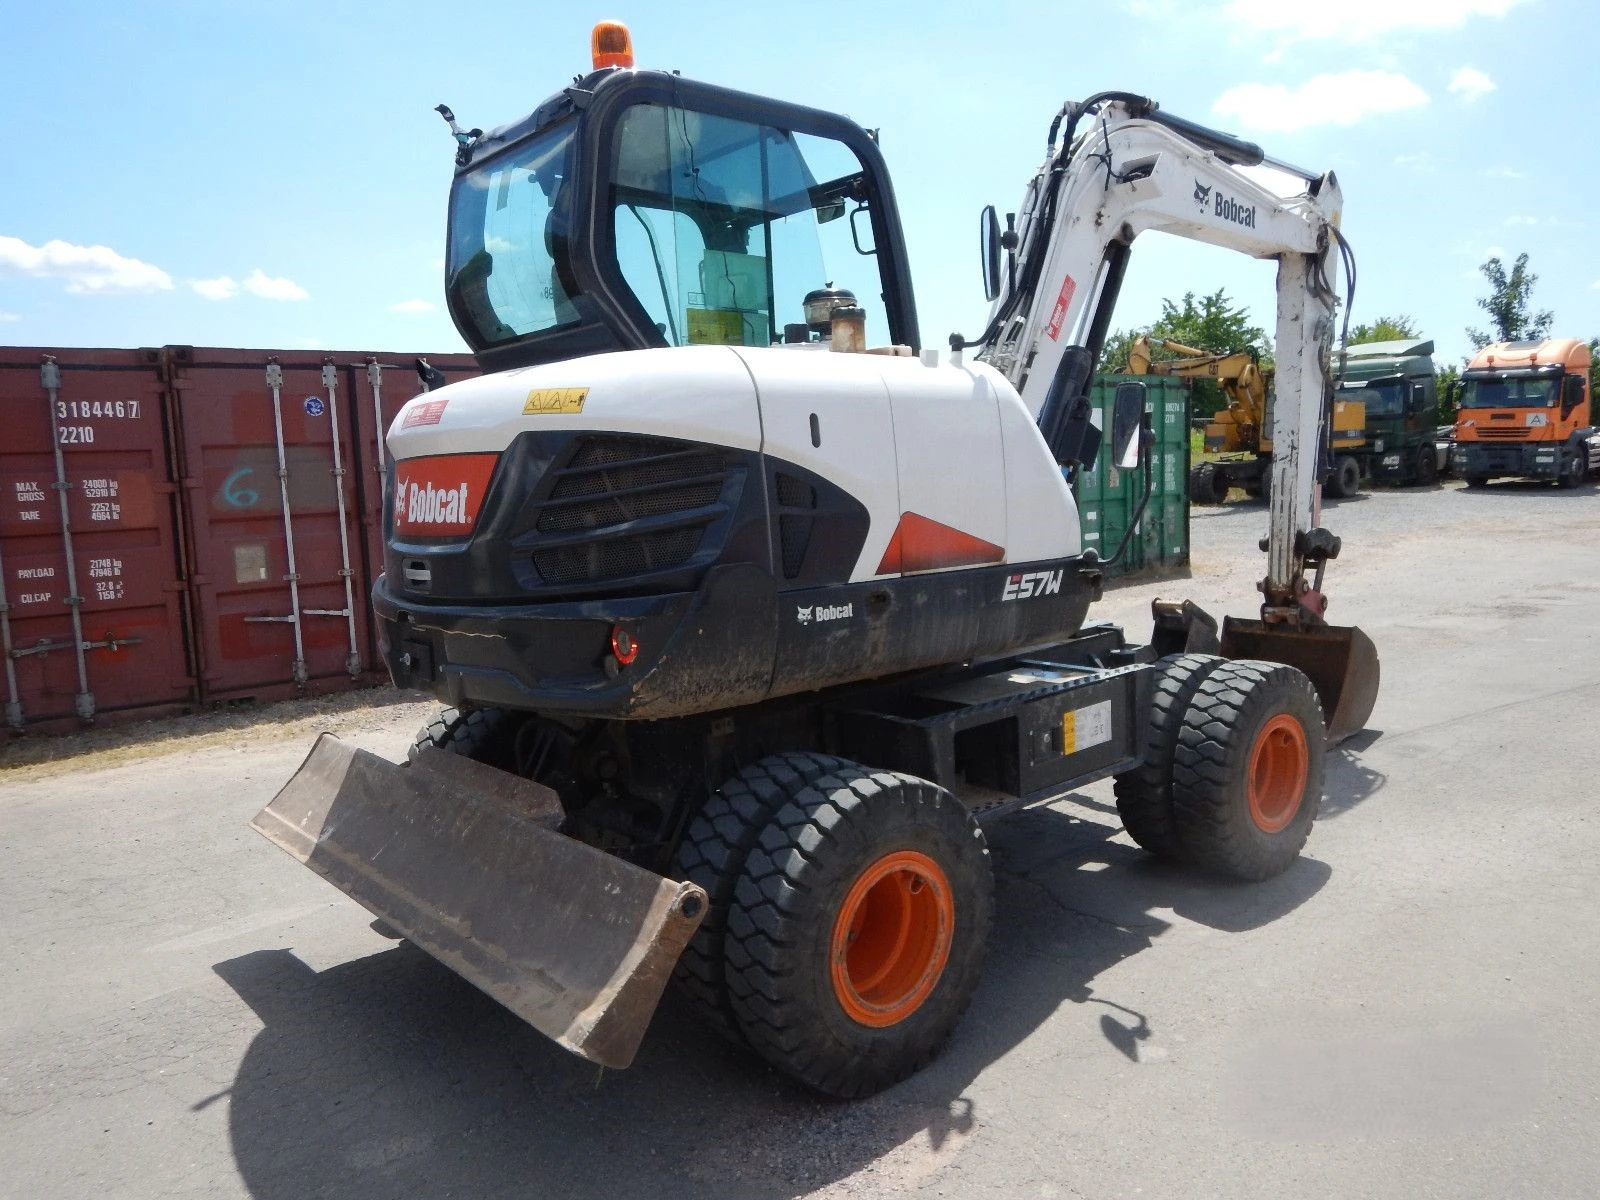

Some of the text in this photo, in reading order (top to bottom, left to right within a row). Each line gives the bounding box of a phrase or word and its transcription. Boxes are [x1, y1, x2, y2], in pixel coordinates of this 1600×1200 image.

[1214, 191, 1256, 229] Bobcat
[59, 426, 94, 443] 2210
[109, 480, 118, 489] kg
[223, 466, 258, 507] 6
[17, 492, 45, 501] GROSS
[111, 489, 117, 497] lb
[91, 503, 120, 512] 2252 kg
[408, 481, 468, 524] Bobcat
[20, 511, 40, 520] TARE
[113, 512, 120, 520] lb
[18, 568, 54, 578] PAYLOAD
[89, 567, 113, 577] 47946
[1002, 569, 1064, 601] E57W
[816, 602, 853, 621] Bobcat
